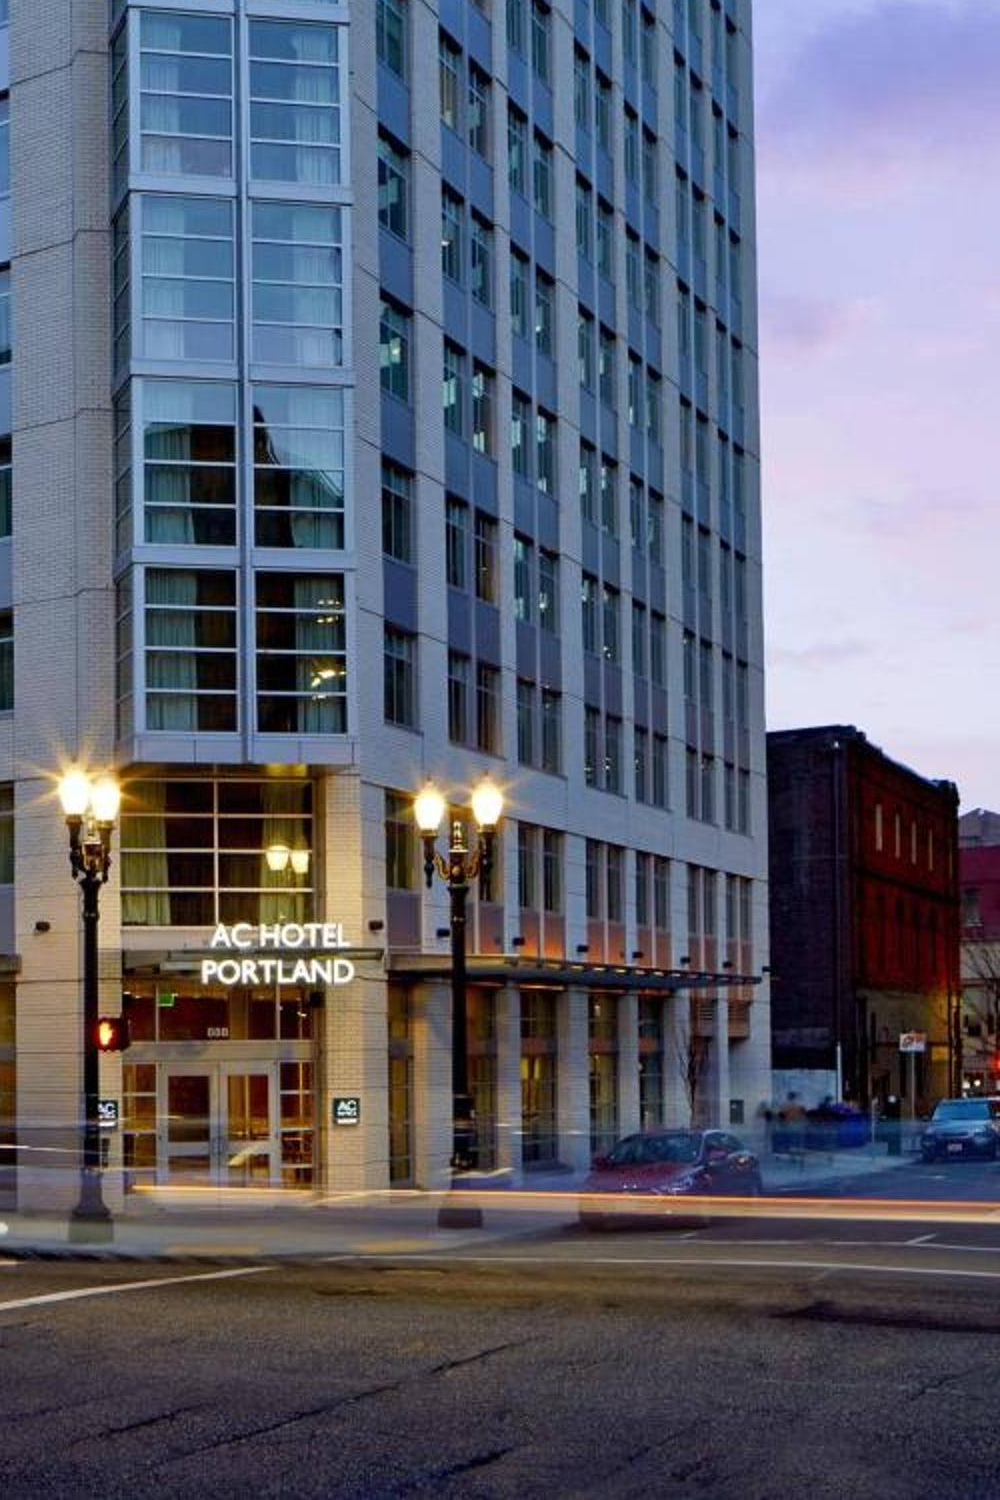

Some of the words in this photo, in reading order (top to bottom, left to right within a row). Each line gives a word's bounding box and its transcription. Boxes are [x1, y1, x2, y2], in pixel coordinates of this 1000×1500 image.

[210, 922, 252, 948] AC
[259, 922, 351, 948] HOTEL
[201, 958, 355, 985] PORTLAND
